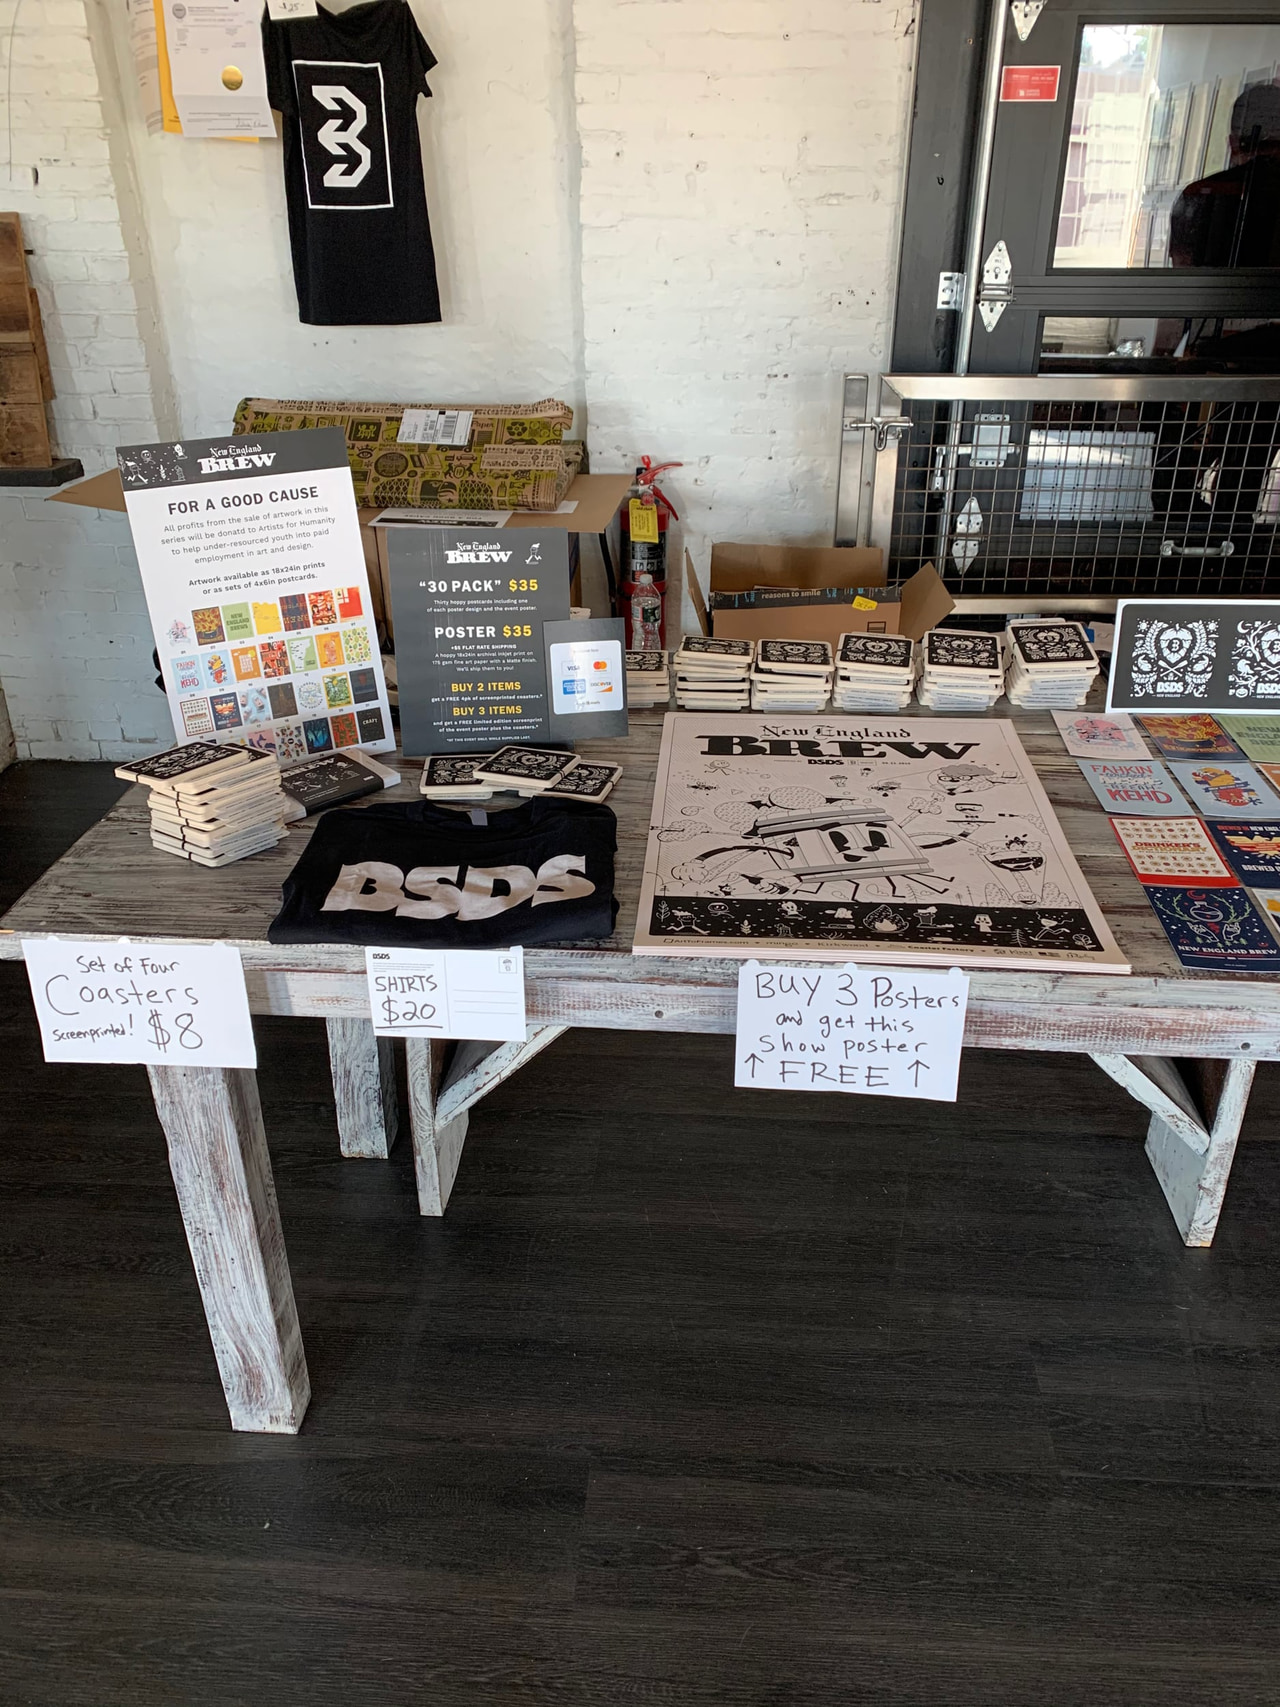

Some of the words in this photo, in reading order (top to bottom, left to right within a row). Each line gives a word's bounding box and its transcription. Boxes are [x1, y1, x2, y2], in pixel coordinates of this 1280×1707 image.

[210, 446, 228, 458] New
[228, 444, 261, 458] England
[197, 453, 276, 474] BREW
[168, 502, 199, 515] FOR
[206, 499, 215, 510] A
[221, 493, 263, 509] GOOD
[269, 487, 318, 502] CAUSE
[161, 536, 185, 544] series
[188, 533, 202, 541] will
[218, 527, 245, 537] donatd
[259, 522, 284, 532] Artists
[300, 516, 336, 527] Humanity
[164, 522, 175, 532] All
[177, 519, 204, 532] profits
[207, 517, 226, 527] from
[228, 516, 241, 524] the
[244, 514, 260, 523] sale
[273, 509, 303, 518] artwork
[182, 544, 201, 555] help
[203, 536, 269, 551] under-resourced
[271, 533, 293, 544] youth
[313, 528, 329, 537] paid
[456, 542, 471, 551] New
[472, 542, 501, 552] England
[194, 551, 244, 564] employment
[270, 544, 284, 553] and
[287, 542, 314, 552] design.
[445, 550, 512, 564] BREW
[189, 576, 221, 586] Artwork
[223, 571, 258, 582] available
[272, 564, 300, 574] 18x24in
[303, 562, 325, 572] prints
[225, 584, 242, 592] sets
[254, 578, 276, 587] 4x6in
[278, 573, 318, 585] postcards.
[509, 578, 538, 592] $35
[761, 590, 790, 599] reasons
[435, 626, 496, 638] POSTER
[503, 625, 532, 638] $35
[451, 683, 473, 692] BUY
[477, 683, 484, 691] 2
[488, 682, 521, 691] ITEMS
[453, 707, 474, 716] BUY
[479, 707, 485, 715] 3
[489, 706, 522, 715] ITEMS
[760, 724, 808, 738] New
[811, 724, 911, 740] England
[694, 735, 980, 760] BREW
[1106, 789, 1173, 804] KEHD
[320, 854, 596, 921] BSDS
[76, 956, 106, 973] Set
[114, 957, 134, 973] of
[139, 958, 181, 975] Four
[375, 975, 438, 993] SHIRTS
[756, 972, 821, 1006] BUY
[835, 974, 858, 1006] 3
[871, 977, 959, 1009] Posters
[45, 974, 199, 1016] Coasters
[382, 995, 436, 1025] $20
[148, 1009, 203, 1053] $8
[776, 1010, 803, 1026] and
[819, 1015, 855, 1038] get
[865, 1017, 914, 1033] this
[843, 1039, 928, 1059] poster
[779, 1060, 890, 1087] FREE
